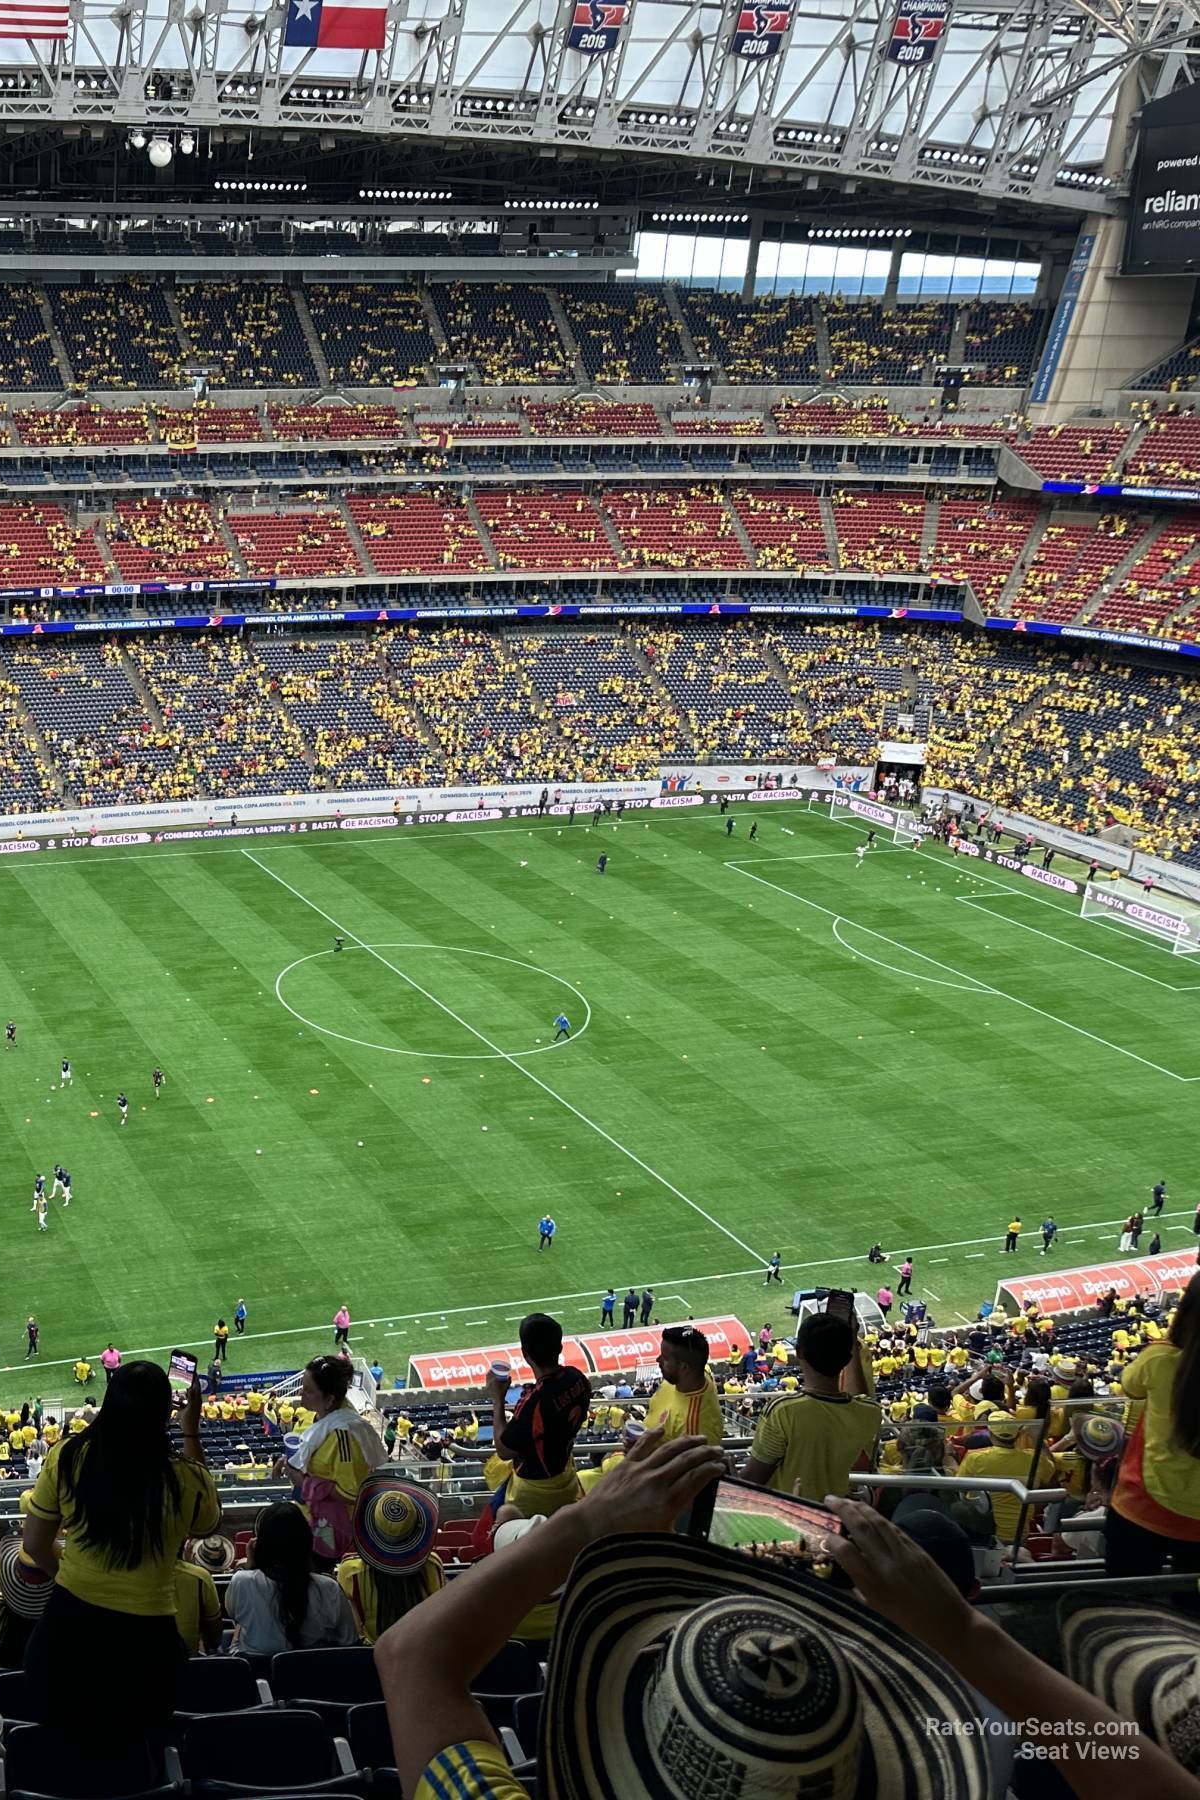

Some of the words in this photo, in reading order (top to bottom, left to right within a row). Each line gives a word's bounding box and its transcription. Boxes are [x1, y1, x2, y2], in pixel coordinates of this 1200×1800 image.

[901, 2, 948, 12] CHAMPIONS
[579, 34, 607, 49] 2016
[741, 40, 769, 54] 2018
[897, 46, 925, 60] 2019
[1157, 155, 1198, 172] powered
[1144, 190, 1200, 214] relian
[1152, 219, 1170, 229] NRG
[1100, 633, 1118, 641] COPA
[1118, 635, 1148, 647] AMERICA
[752, 791, 764, 799] DE
[767, 790, 799, 799] RACISMO
[624, 800, 648, 808] STOP
[660, 797, 693, 805] RACISM
[825, 795, 848, 806] STOP
[857, 803, 885, 819] RACISM
[312, 821, 337, 829] BASTA
[359, 818, 395, 827] RACISMO
[419, 814, 444, 823] STOP
[456, 811, 491, 820] RACISM
[164, 832, 203, 840] CONMEBOL
[222, 828, 254, 836] AMERICA
[62, 838, 88, 848] STOP
[102, 835, 139, 844] RACISM
[997, 855, 1021, 870] STOP
[1031, 868, 1066, 888] RACISM
[1097, 894, 1124, 910] BASTA
[1131, 906, 1143, 917] DE
[1145, 910, 1186, 933] RACISMO
[1022, 1285, 1071, 1300] Betano
[1082, 1278, 1129, 1295] Betano
[599, 1340, 653, 1359] Betano
[430, 1363, 487, 1381] Betano
